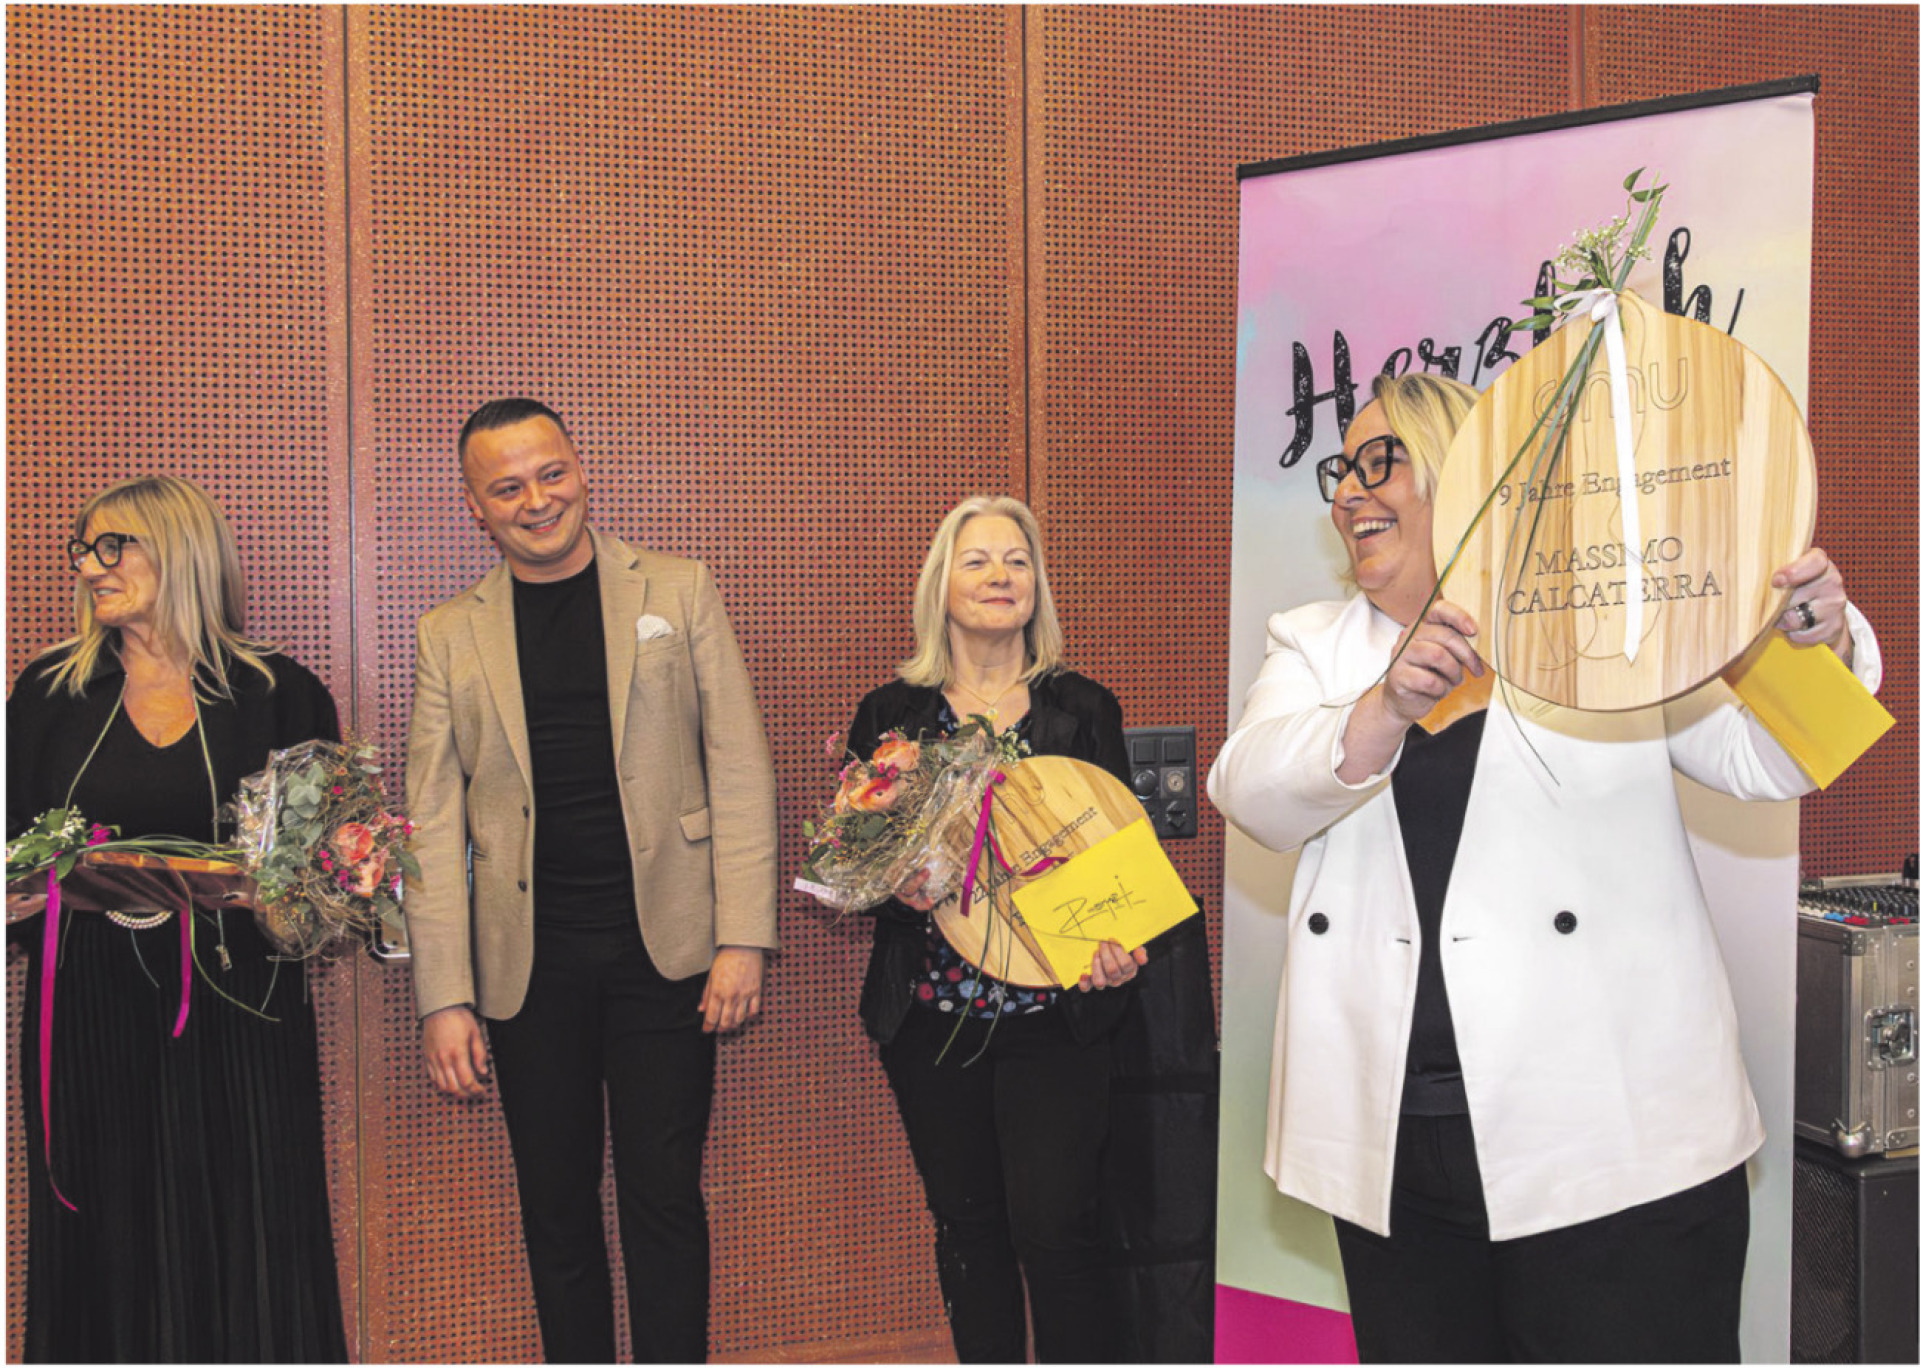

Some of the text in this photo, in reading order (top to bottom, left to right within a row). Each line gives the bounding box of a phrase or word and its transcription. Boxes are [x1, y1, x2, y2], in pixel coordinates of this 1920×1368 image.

[1279, 227, 1745, 468] Herzlh
[1500, 484, 1512, 506] 9
[1582, 457, 1732, 497] Enagement
[1535, 536, 1684, 576] MASSIMO
[1507, 570, 1723, 615] CALCATERRA
[1018, 806, 1098, 867] Engagement
